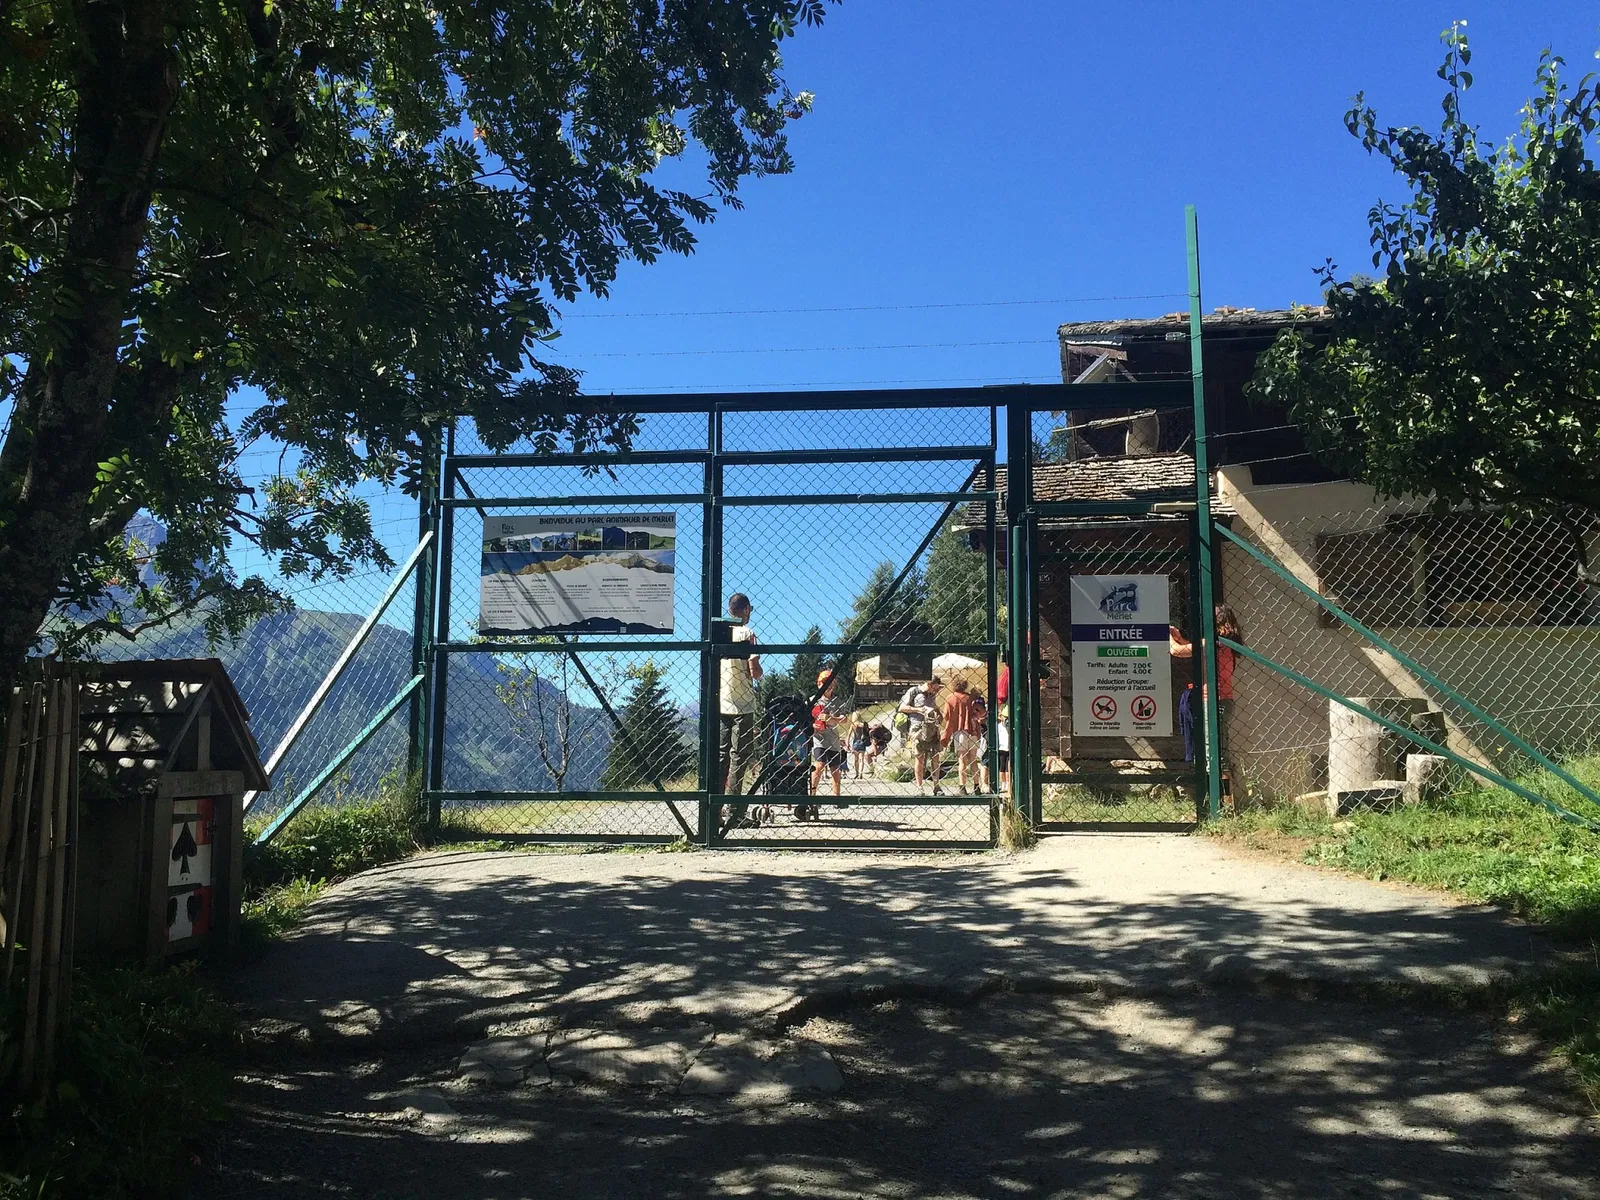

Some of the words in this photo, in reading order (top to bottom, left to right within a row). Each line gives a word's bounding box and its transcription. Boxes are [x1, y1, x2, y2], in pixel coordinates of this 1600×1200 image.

[539, 517, 573, 525] BIENVENUE
[587, 517, 604, 525] PARC
[652, 515, 674, 523] MERLET
[1106, 598, 1132, 611] Parc
[1099, 625, 1143, 640] ENTRÉE
[1107, 648, 1138, 656] OUVERT
